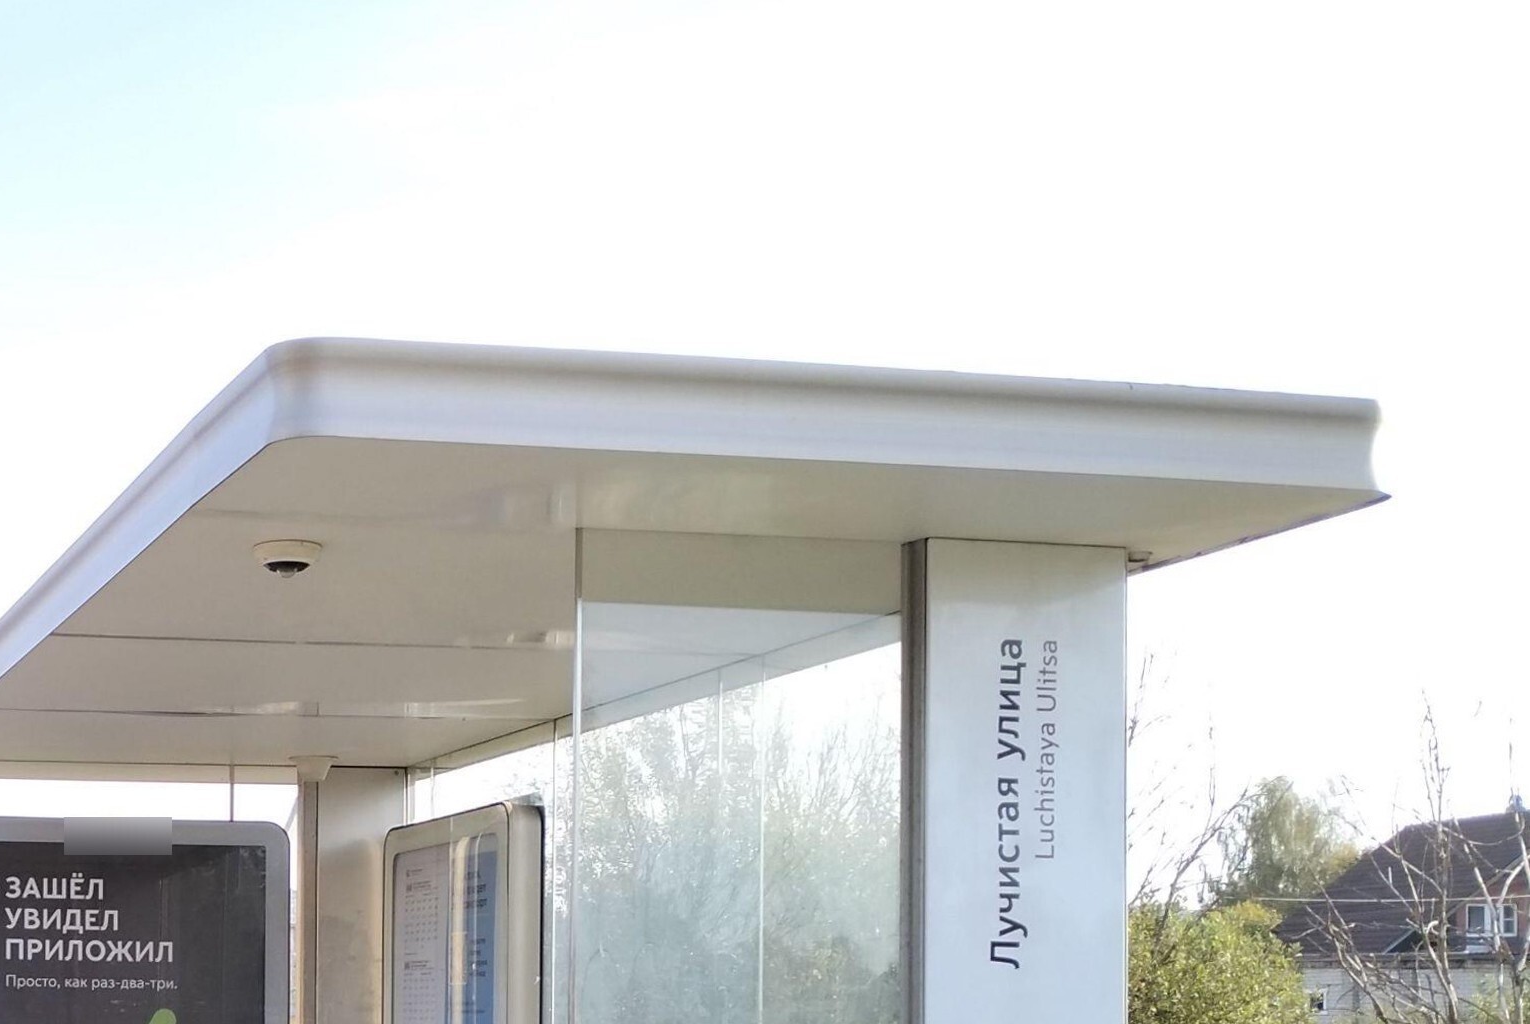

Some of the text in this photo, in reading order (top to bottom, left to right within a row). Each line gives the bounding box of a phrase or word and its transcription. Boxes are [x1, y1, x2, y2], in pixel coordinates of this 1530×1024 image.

[1034, 640, 1060, 859] Luchistaya Ulitsa
[990, 639, 1028, 970] Лучистая улица
[5, 872, 104, 900] ЗАШЁЛ
[4, 907, 119, 935] УВИДЕЛ
[5, 938, 174, 963] ПРИЛОЖИЛ
[5, 974, 178, 992] Просто, как раз-два-три.
